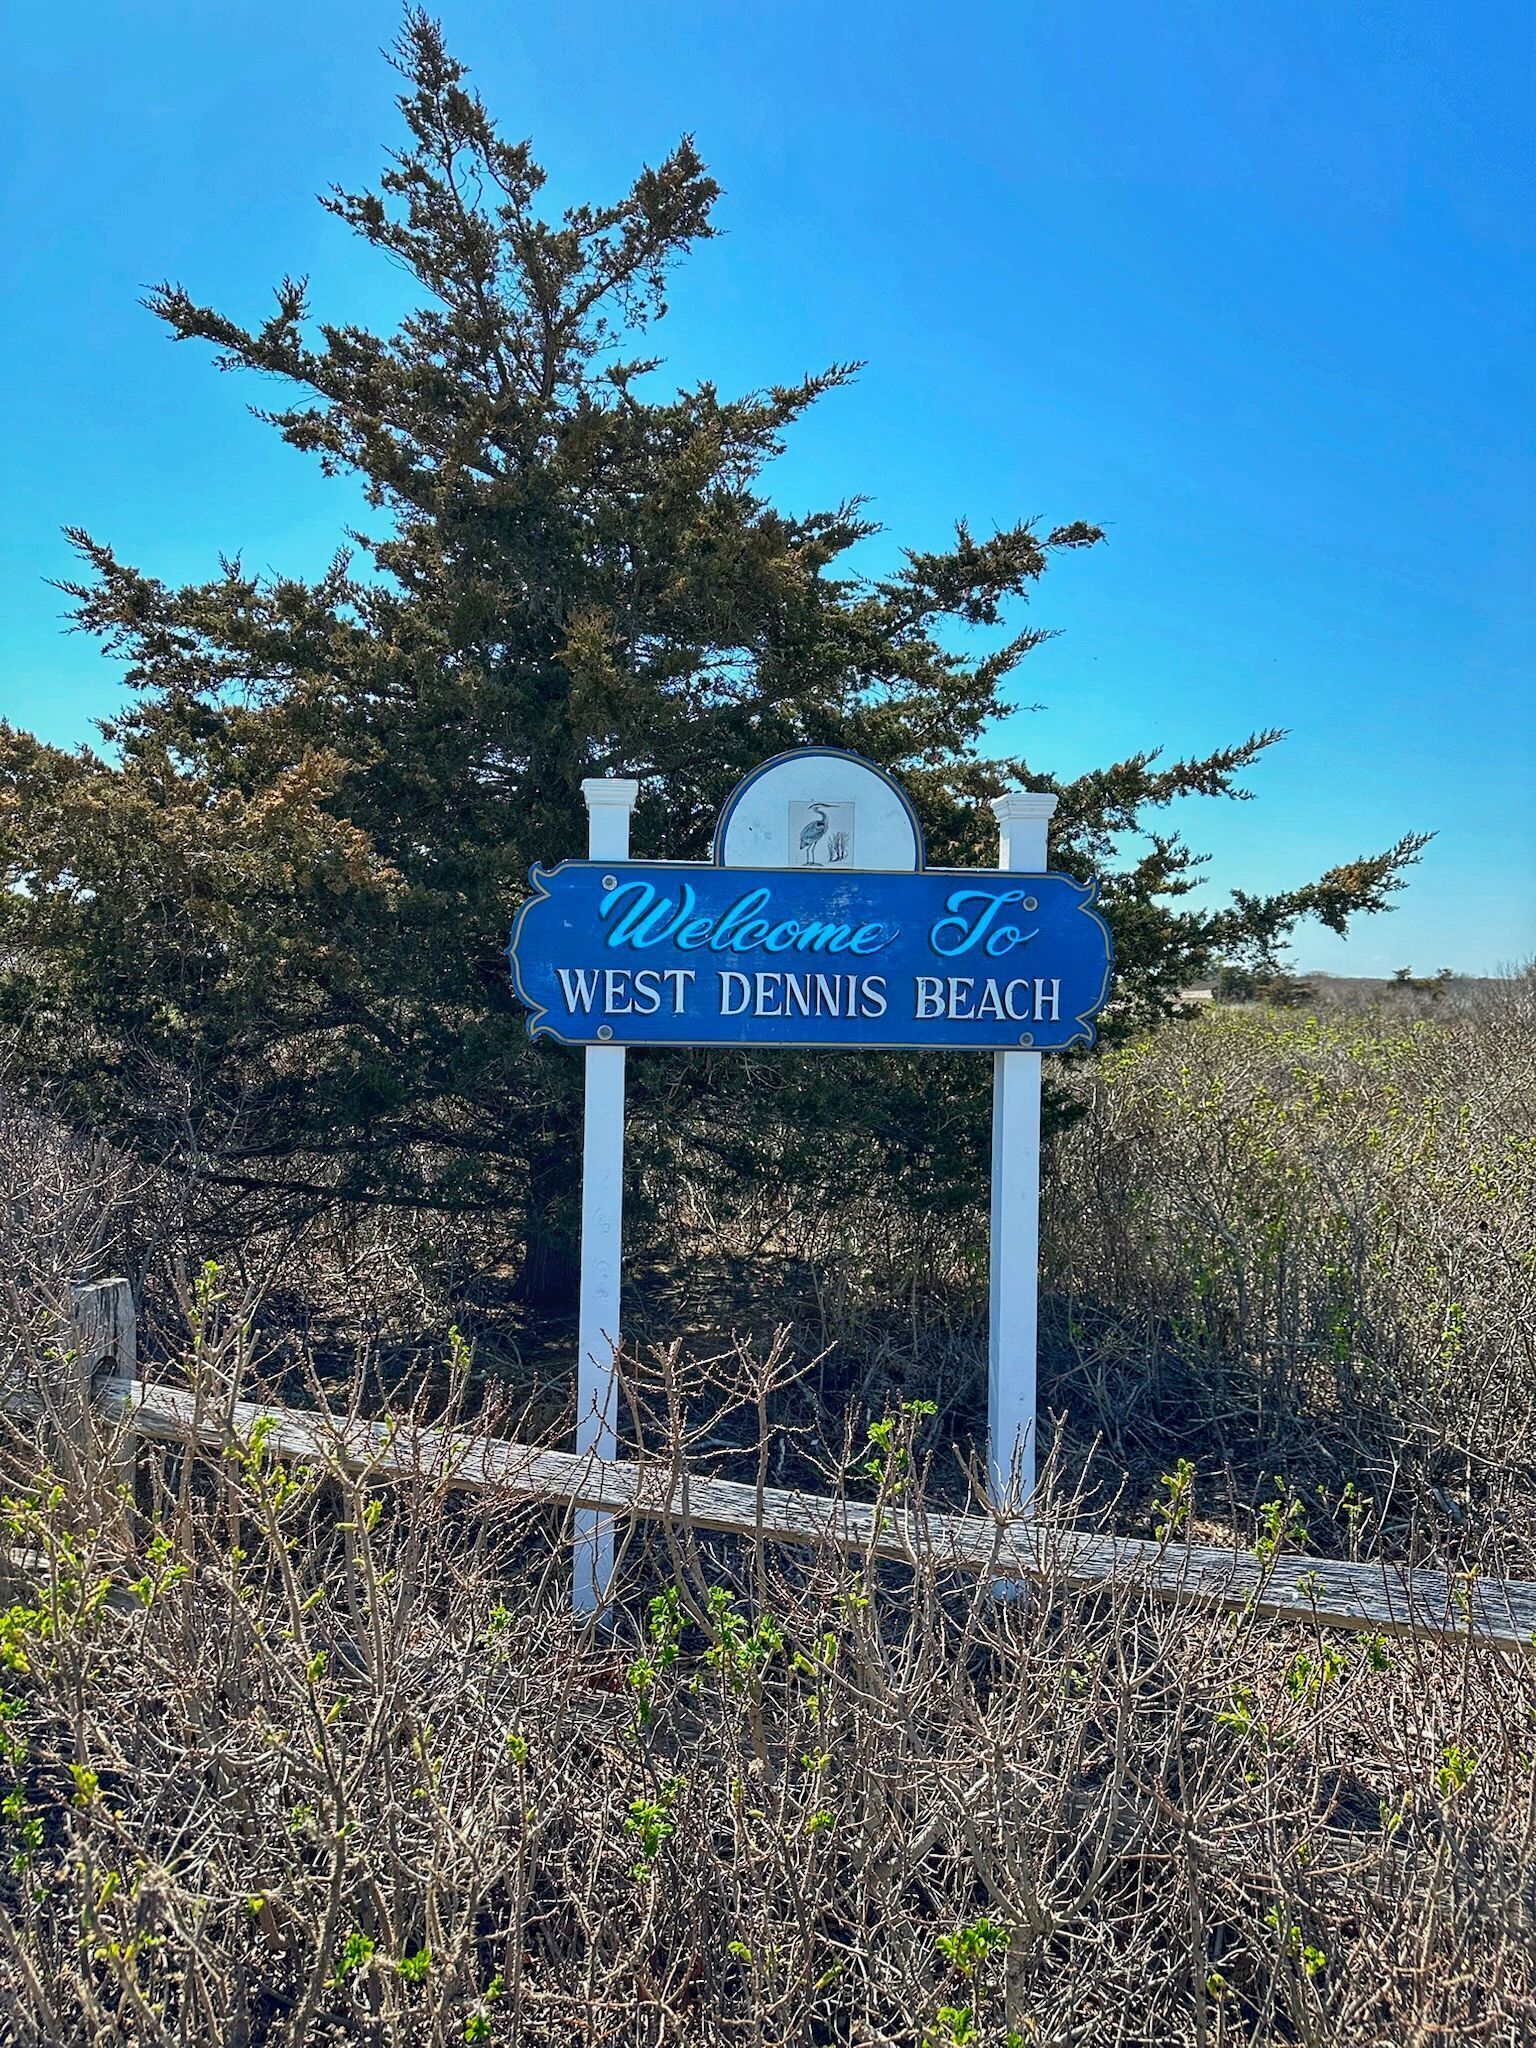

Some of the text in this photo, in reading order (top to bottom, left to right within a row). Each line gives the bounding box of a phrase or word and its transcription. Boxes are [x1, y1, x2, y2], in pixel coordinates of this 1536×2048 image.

[600, 881, 1039, 957] Welcome To
[557, 968, 1062, 1022] WEST DENNIS BEACH
